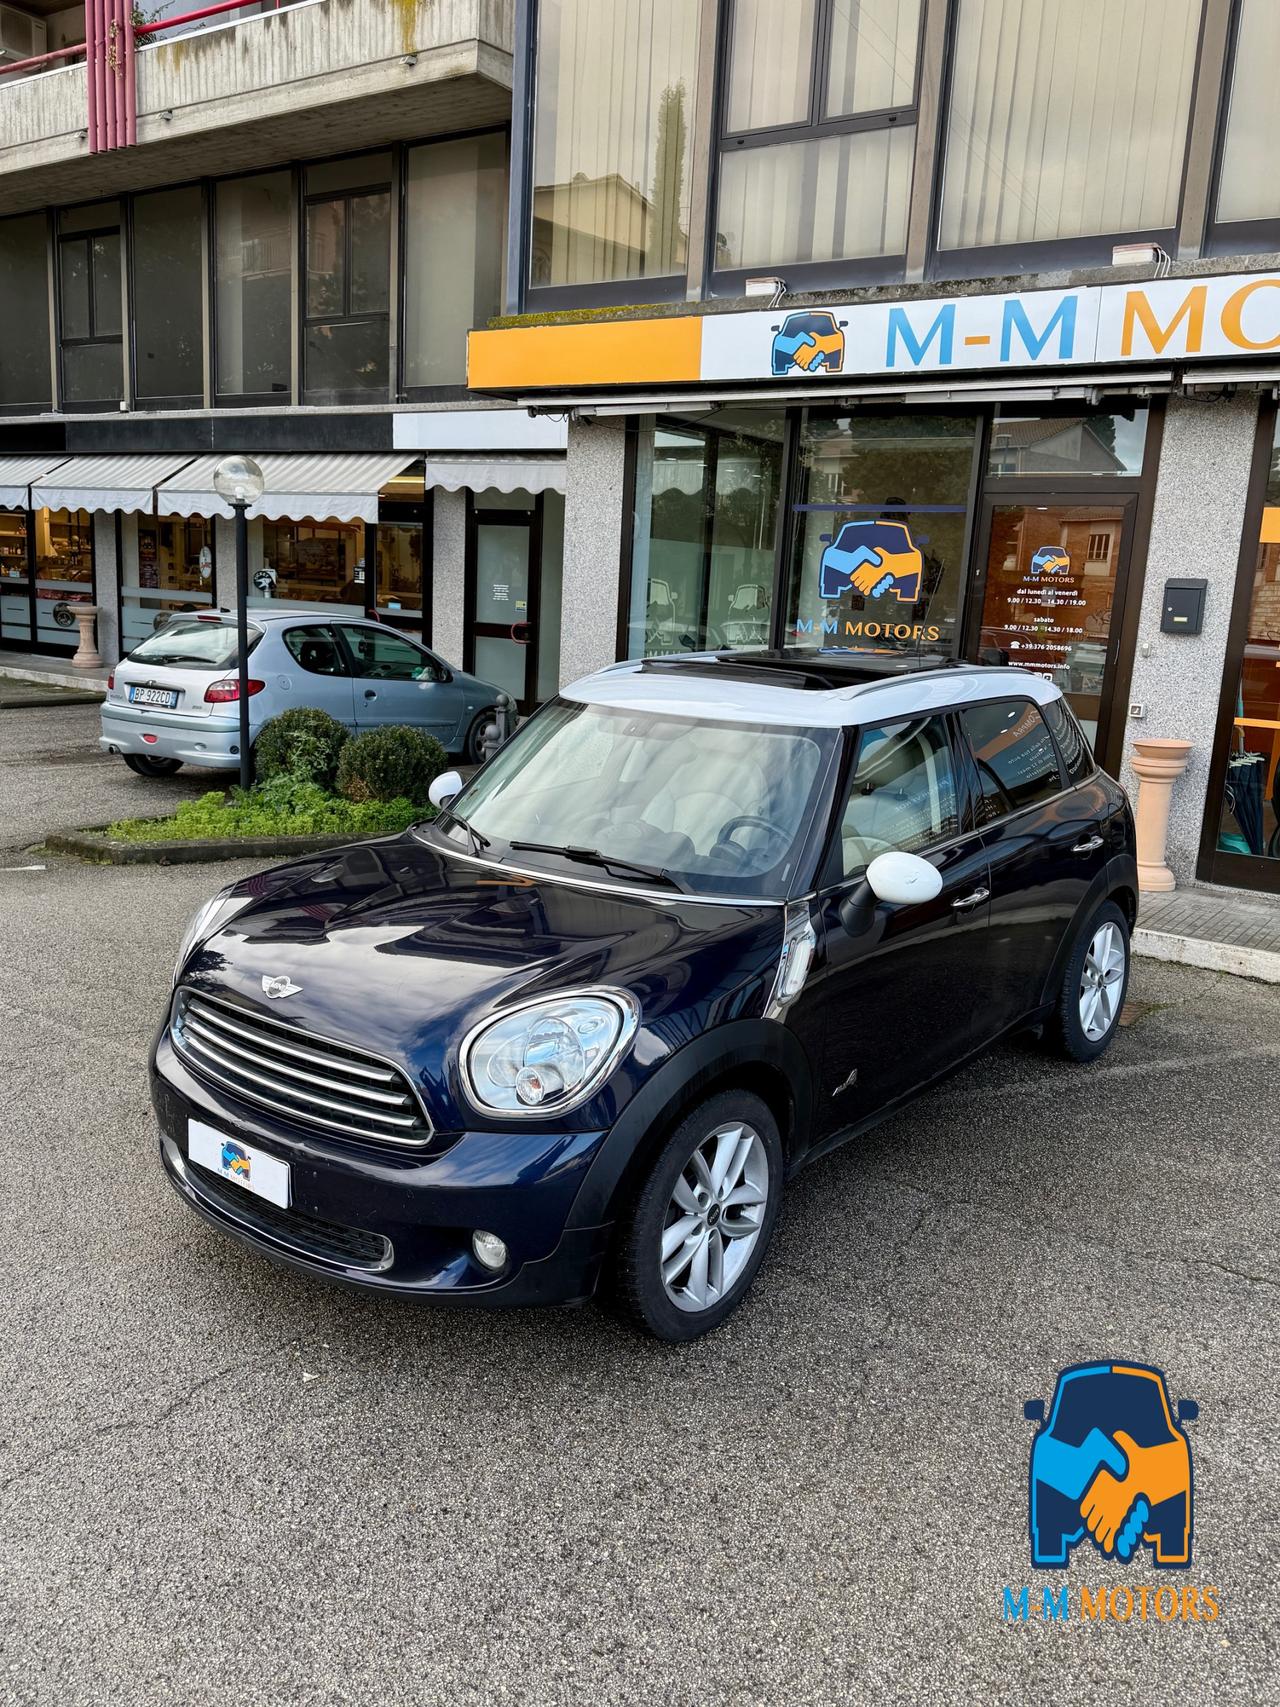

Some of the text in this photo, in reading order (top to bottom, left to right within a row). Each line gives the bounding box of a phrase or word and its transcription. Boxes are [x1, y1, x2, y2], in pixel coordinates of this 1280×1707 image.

[885, 295, 1079, 367] M-M
[796, 619, 941, 641] M-M MOTORS
[134, 688, 171, 704] BP 922CD
